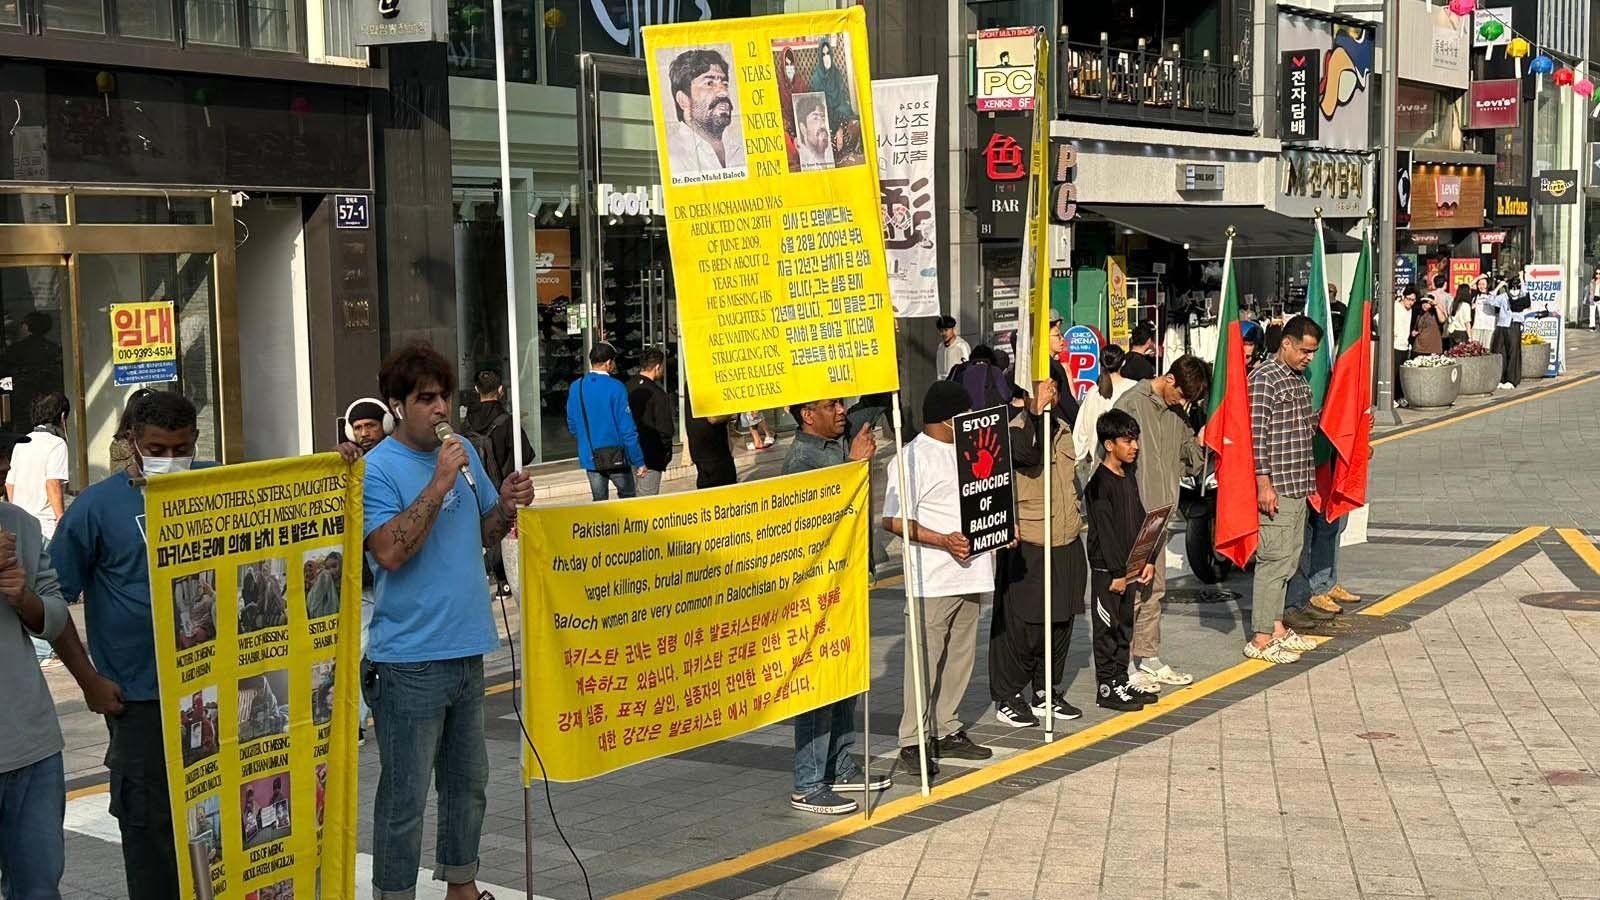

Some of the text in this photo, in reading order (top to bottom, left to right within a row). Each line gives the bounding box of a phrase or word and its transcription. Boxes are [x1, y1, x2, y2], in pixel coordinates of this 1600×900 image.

[747, 41, 757, 58] 12
[741, 66, 772, 83] YEARS
[984, 69, 1033, 96] PC
[752, 90, 765, 105] OF
[984, 98, 1031, 109] XENICS 6F
[1291, 70, 1307, 136] 전자담배
[747, 112, 779, 129] NEVER
[746, 136, 784, 156] ENDING
[982, 132, 1026, 180] 色
[671, 170, 746, 185] Dr. Deen Baloch
[1057, 143, 1077, 221] PC
[598, 183, 649, 216] Foot
[689, 195, 783, 218] DEEN MOHAMMAD WAS
[991, 199, 1020, 212] BAR
[339, 205, 365, 220] 57-1
[691, 215, 772, 237] ABDUCTED ON 28TH
[981, 224, 992, 234] B1
[708, 237, 740, 255] OF JUNE
[781, 229, 847, 254] 6월 28일 2009년
[712, 253, 770, 272] BEEN ABOUT 12
[777, 259, 793, 277] 지금
[712, 273, 759, 290] YEARS THAT
[707, 290, 773, 310] HE MISSING HIS
[827, 298, 842, 315] 그의
[1532, 292, 1556, 301] SALE
[115, 307, 172, 346] 임대
[717, 309, 767, 327] DAUGHTERS
[708, 326, 780, 347] ARE WAITING AND
[118, 346, 173, 359] 010-9393-4514
[712, 344, 781, 366] STRUGGLING FOR
[714, 370, 728, 383] HIS
[728, 366, 747, 382] SAFE
[827, 364, 854, 383] 입니다.
[722, 385, 756, 401] SINCE 12
[962, 413, 1000, 432] STOP
[962, 472, 1010, 497] GENOCIDE
[162, 473, 348, 518] HAPLESS MOTHERS, SISTERS, DAUGHTERS
[980, 496, 992, 511] OF
[159, 502, 307, 542] AND WIVES OF BALOCH MISSING
[572, 483, 841, 540] Pakistani Army continues its Barbarism in Balochistan since
[969, 510, 1007, 533] BALOCH
[228, 515, 345, 554] 의해 납치 된 발로츠 사람
[973, 528, 1008, 551] NATION
[552, 556, 570, 571] the
[570, 554, 588, 572] day
[591, 551, 602, 569] of
[666, 537, 702, 557] Military
[704, 531, 754, 552] operations,
[756, 521, 792, 541] enforced
[654, 570, 683, 589] brutal
[686, 564, 721, 583] murders
[724, 559, 735, 575] of
[735, 554, 768, 572] missing
[769, 546, 805, 566] persons,
[553, 561, 824, 630] Baloch women are very common in Balochistan by Pakistani
[564, 647, 619, 669] 파키스탄
[625, 641, 652, 664] 군대는
[656, 633, 678, 655] 점령
[683, 627, 705, 648] 이후
[709, 608, 779, 642] 발로치스탄에서
[781, 597, 812, 620] 야만적
[576, 623, 810, 696] 계속하고 있습니다. 파키스탄 군대로 인한 군사
[558, 636, 851, 733] 강제 실종, 표적 살인, 실종자의 잔인한 살인, 여성에
[598, 692, 771, 752] 대한 강간은 발로치스탄 에서 매우
